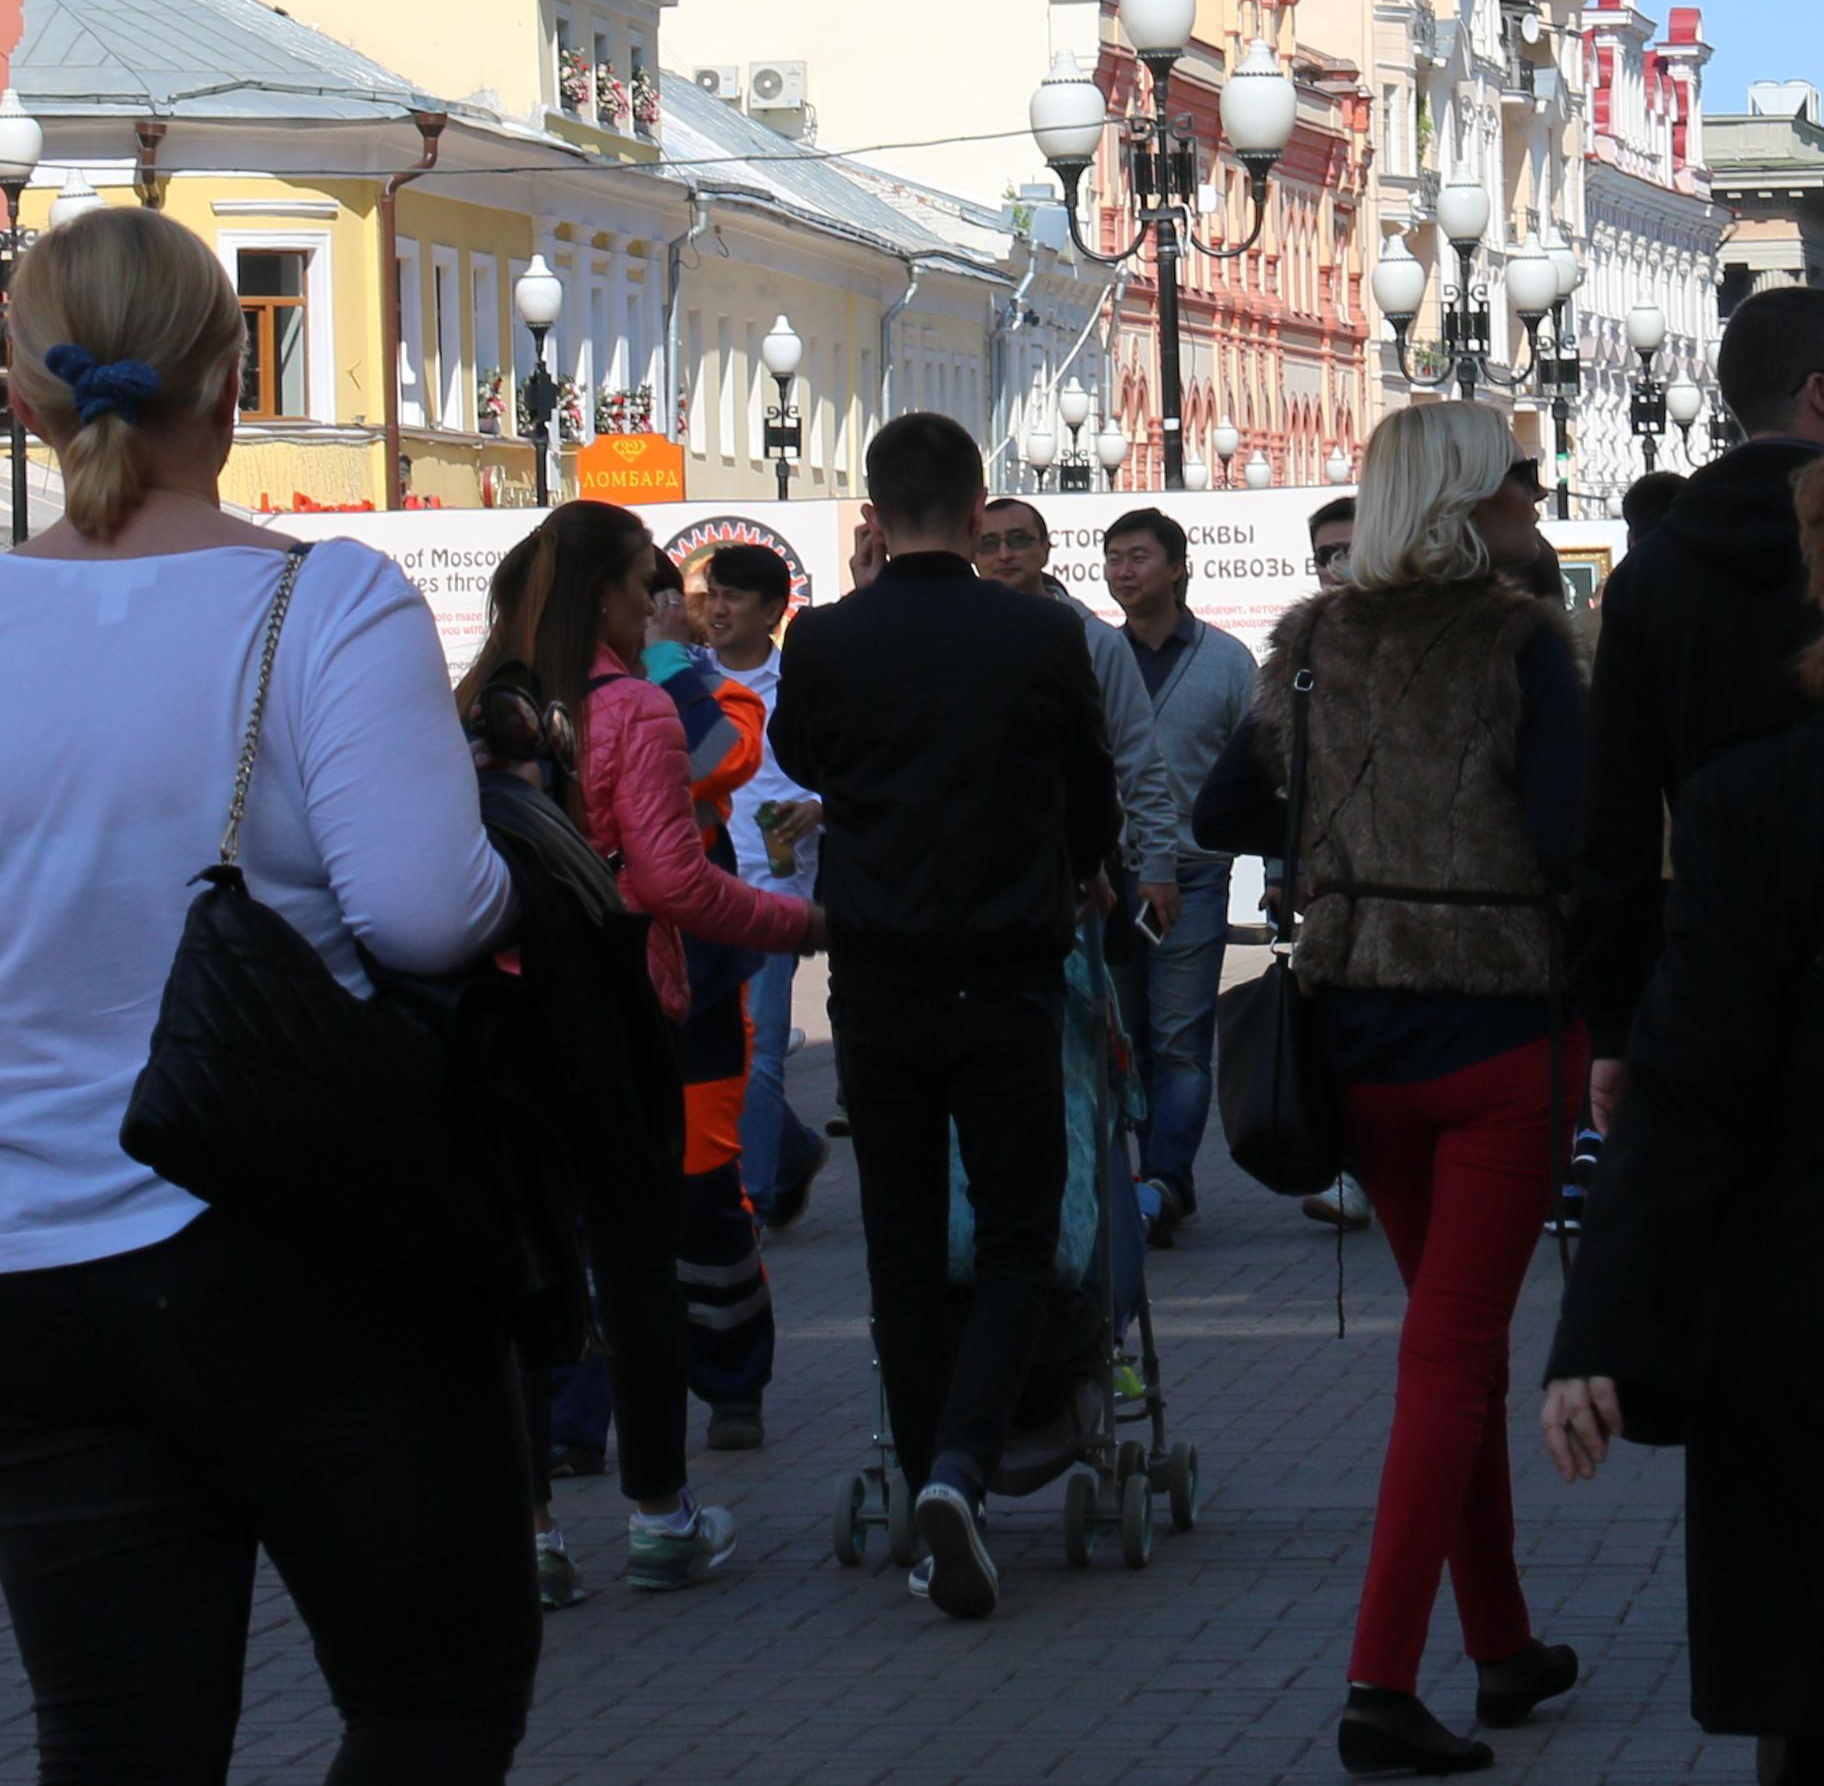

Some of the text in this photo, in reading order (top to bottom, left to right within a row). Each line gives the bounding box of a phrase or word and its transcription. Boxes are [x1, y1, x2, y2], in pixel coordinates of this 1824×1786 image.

[582, 469, 680, 489] ЛОМБАРД
[1188, 524, 1254, 545] СКВЫ
[404, 548, 424, 568] of
[1203, 558, 1295, 578] СКВОЗЬ
